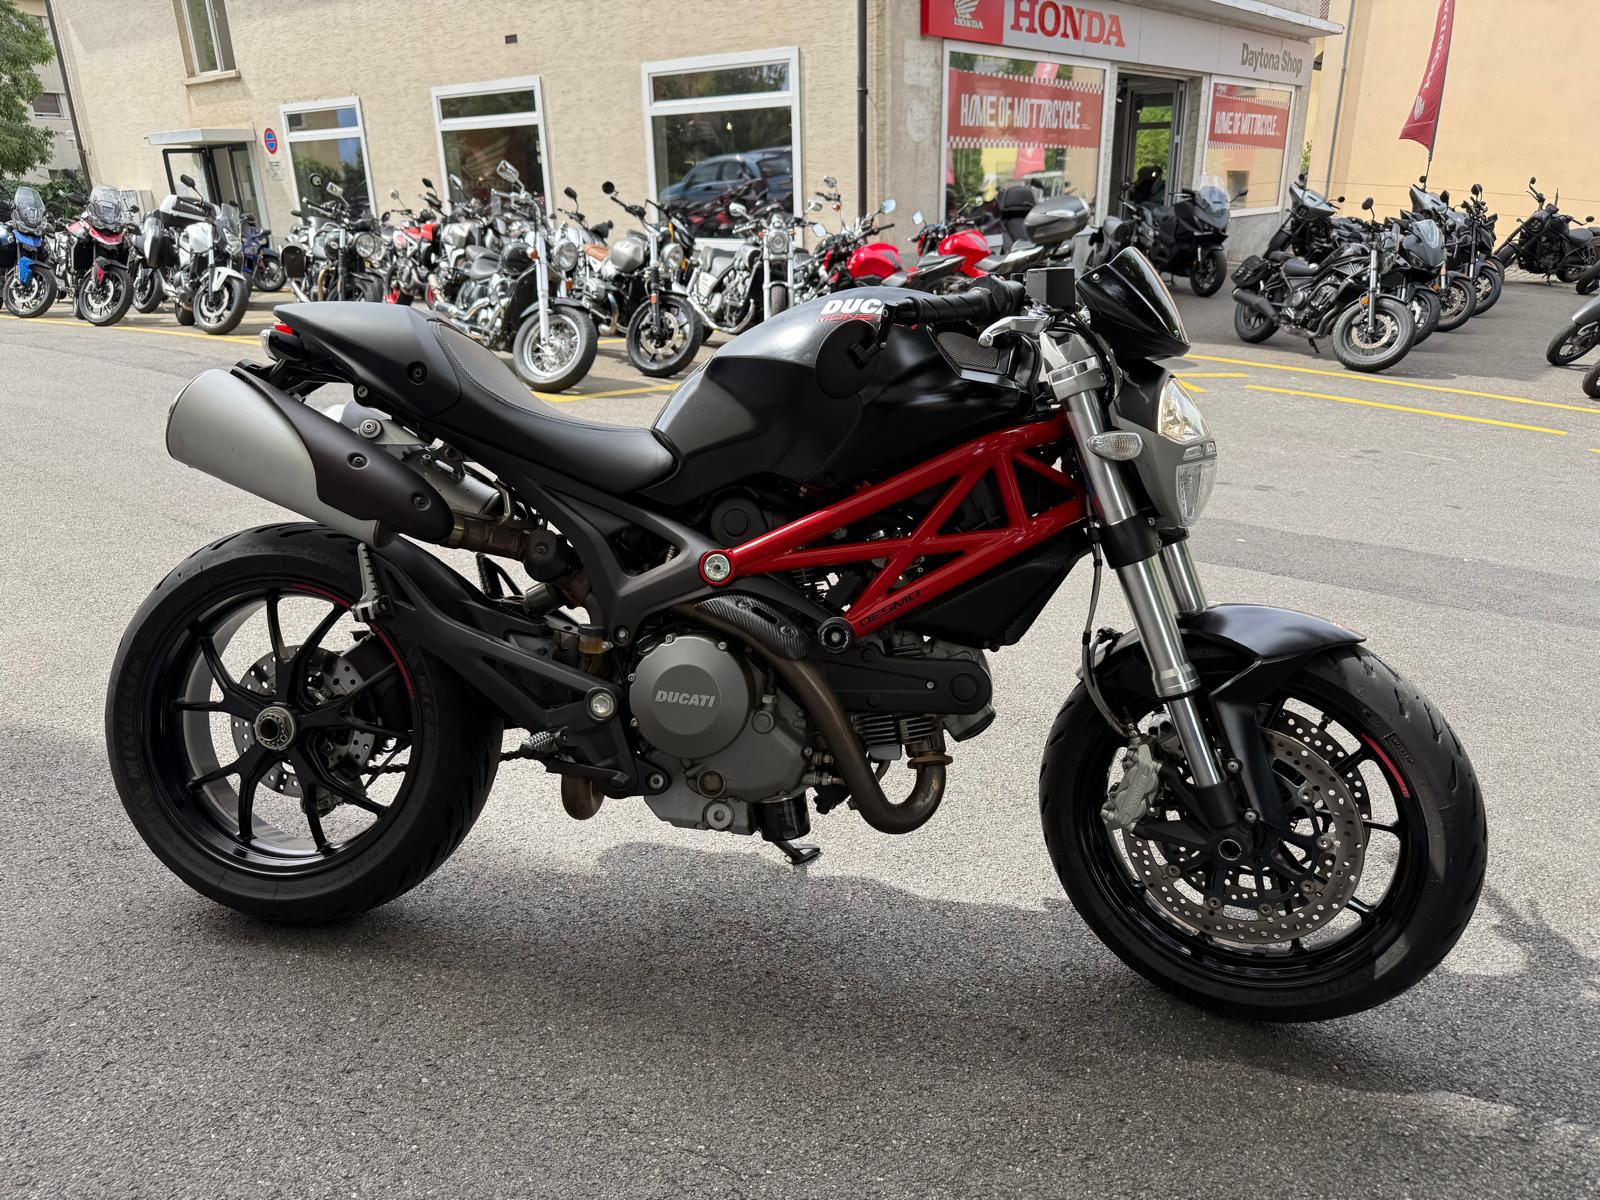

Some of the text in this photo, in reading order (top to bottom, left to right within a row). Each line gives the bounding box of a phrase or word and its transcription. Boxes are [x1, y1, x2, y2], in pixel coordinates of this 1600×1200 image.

[953, 17, 984, 30] HONDA
[1010, 0, 1125, 48] HONDA
[1240, 42, 1303, 78] Daytona Shop
[960, 93, 997, 127] HOME
[998, 96, 1013, 128] OF
[860, 589, 922, 627] DESMO
[655, 690, 716, 708] DUCATI
